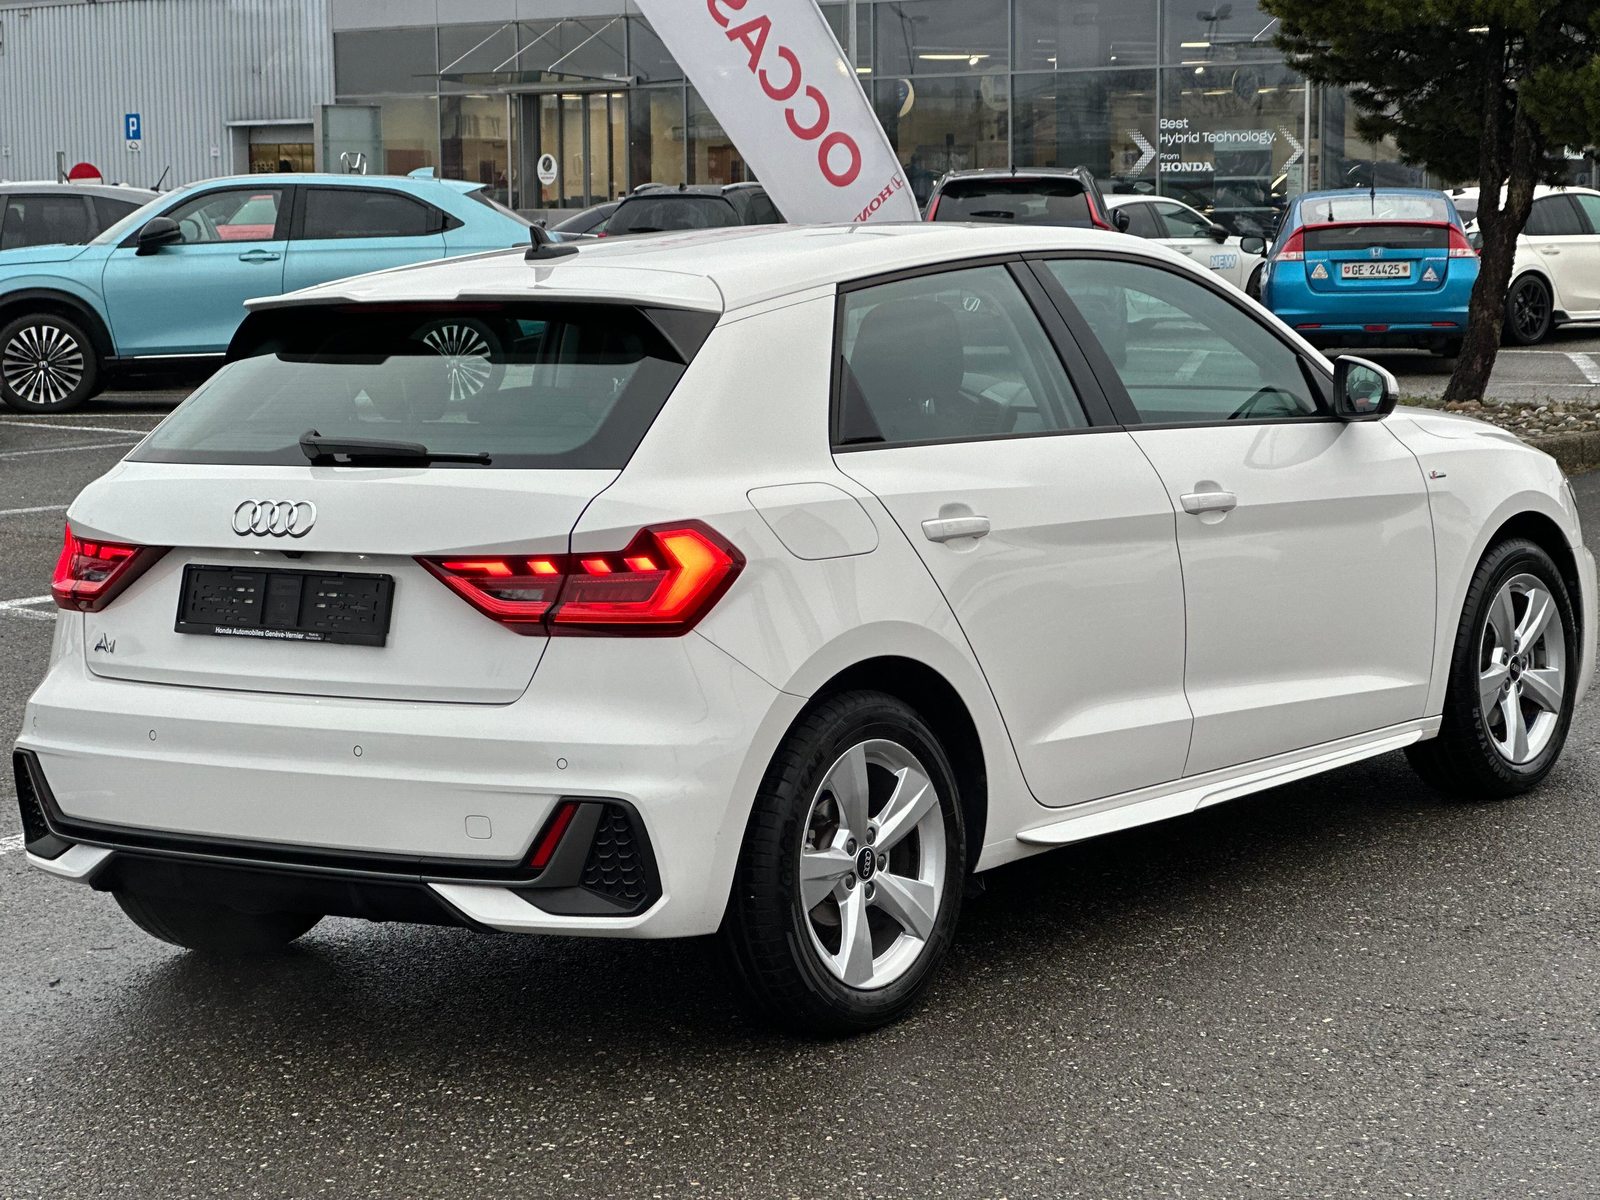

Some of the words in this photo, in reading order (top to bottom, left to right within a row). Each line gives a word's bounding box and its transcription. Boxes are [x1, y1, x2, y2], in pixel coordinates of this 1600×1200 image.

[129, 117, 137, 137] P
[1160, 118, 1189, 129] Best
[1160, 131, 1200, 146] Hybrid
[1160, 152, 1180, 160] From
[1160, 161, 1214, 172] HONDA
[1210, 254, 1237, 269] NEW
[215, 626, 232, 634] Honda
[232, 628, 264, 637] Automobiles
[94, 632, 116, 654] A1
